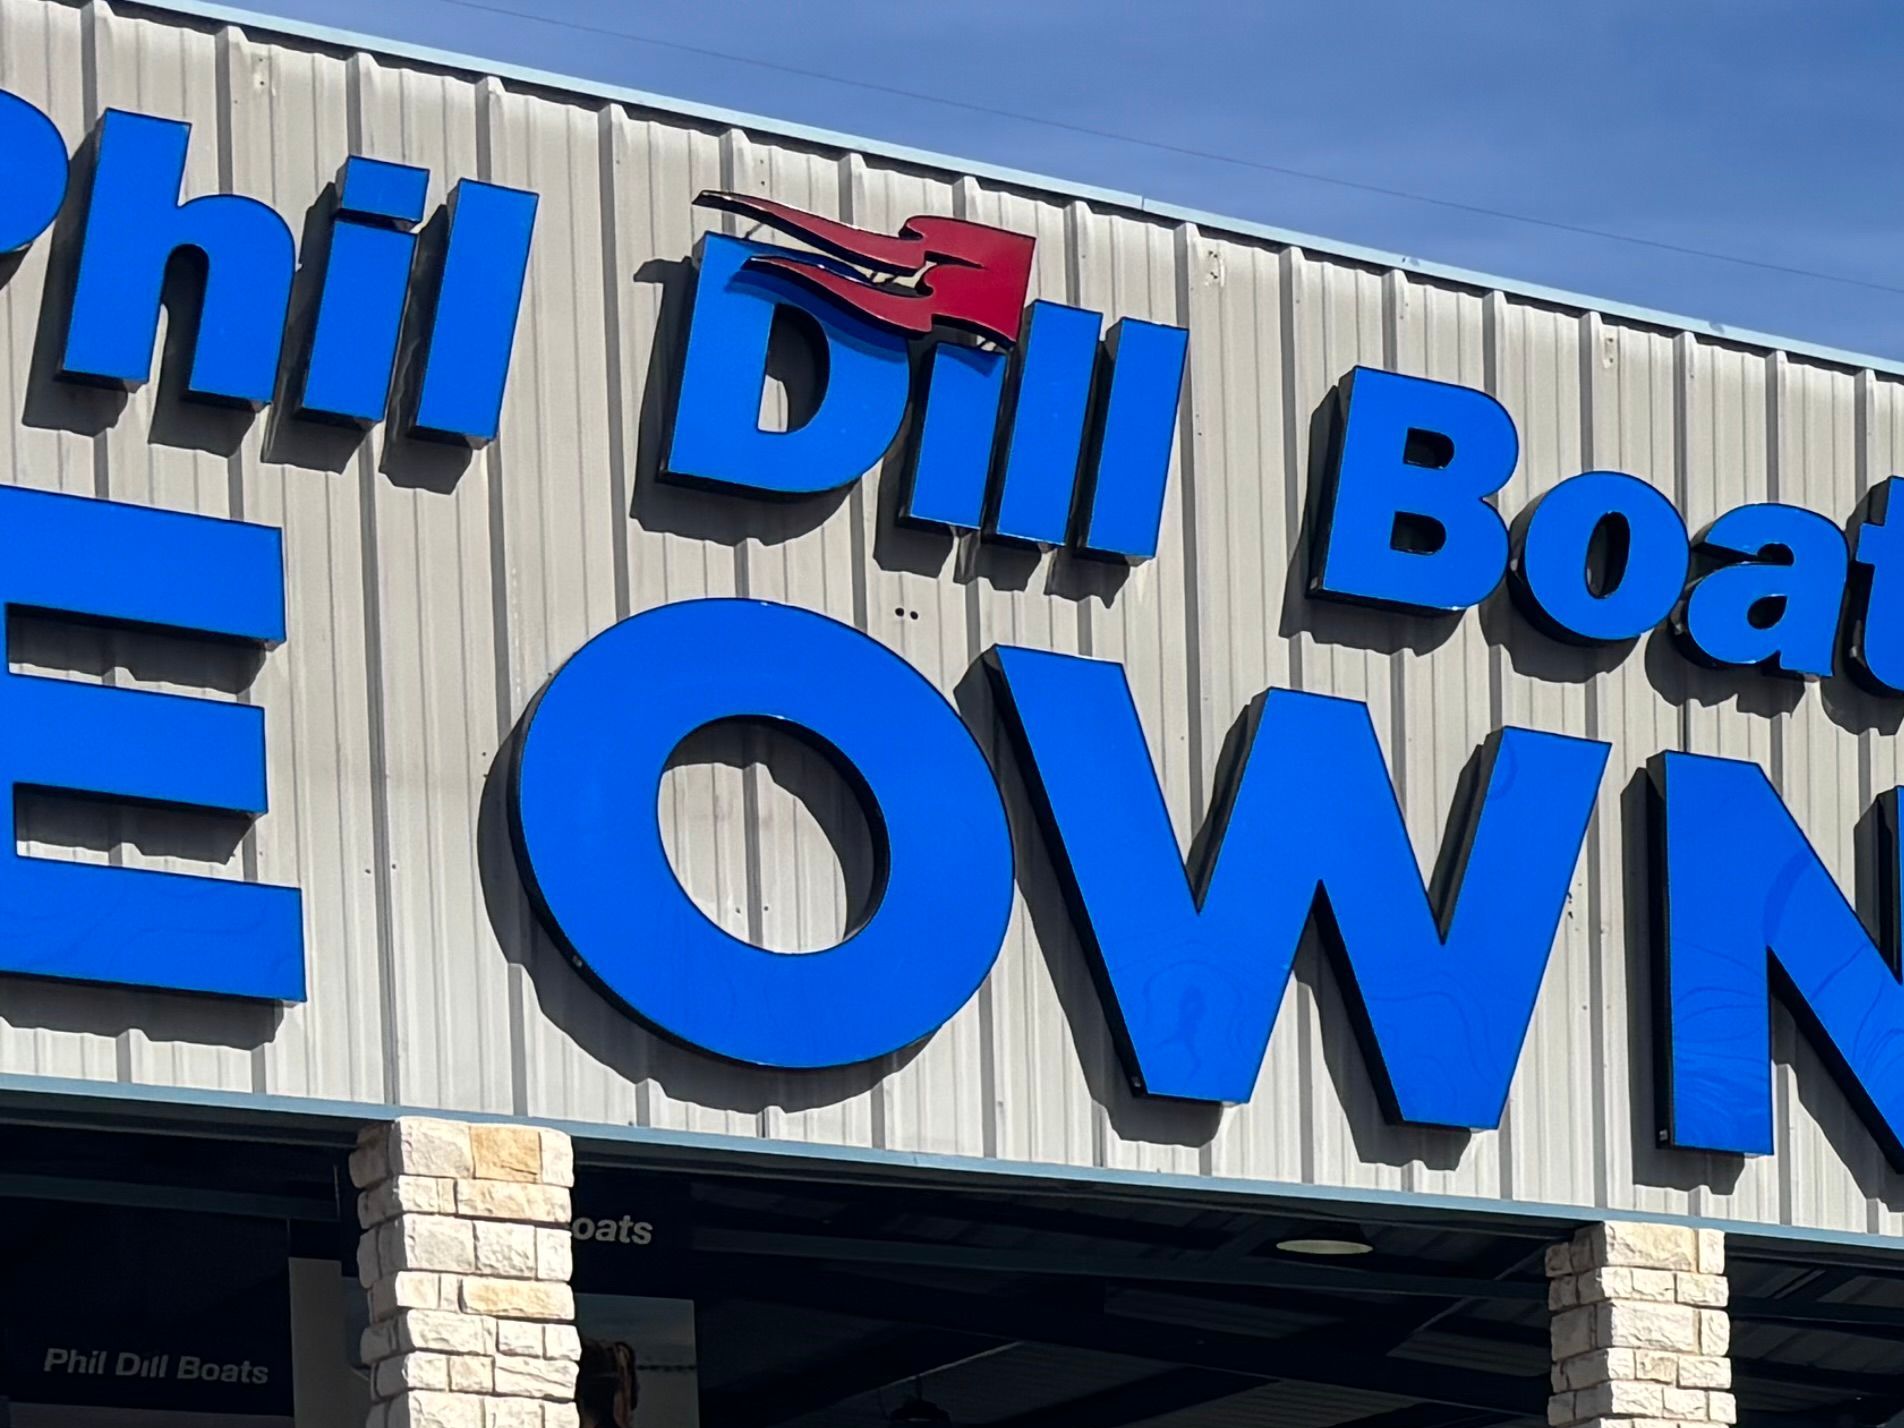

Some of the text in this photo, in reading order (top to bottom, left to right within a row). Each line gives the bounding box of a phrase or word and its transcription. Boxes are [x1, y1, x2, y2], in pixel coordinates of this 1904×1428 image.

[659, 232, 1189, 566] Dill
[572, 1213, 654, 1247] oats
[43, 1347, 269, 1386] Phil Dill Boats
